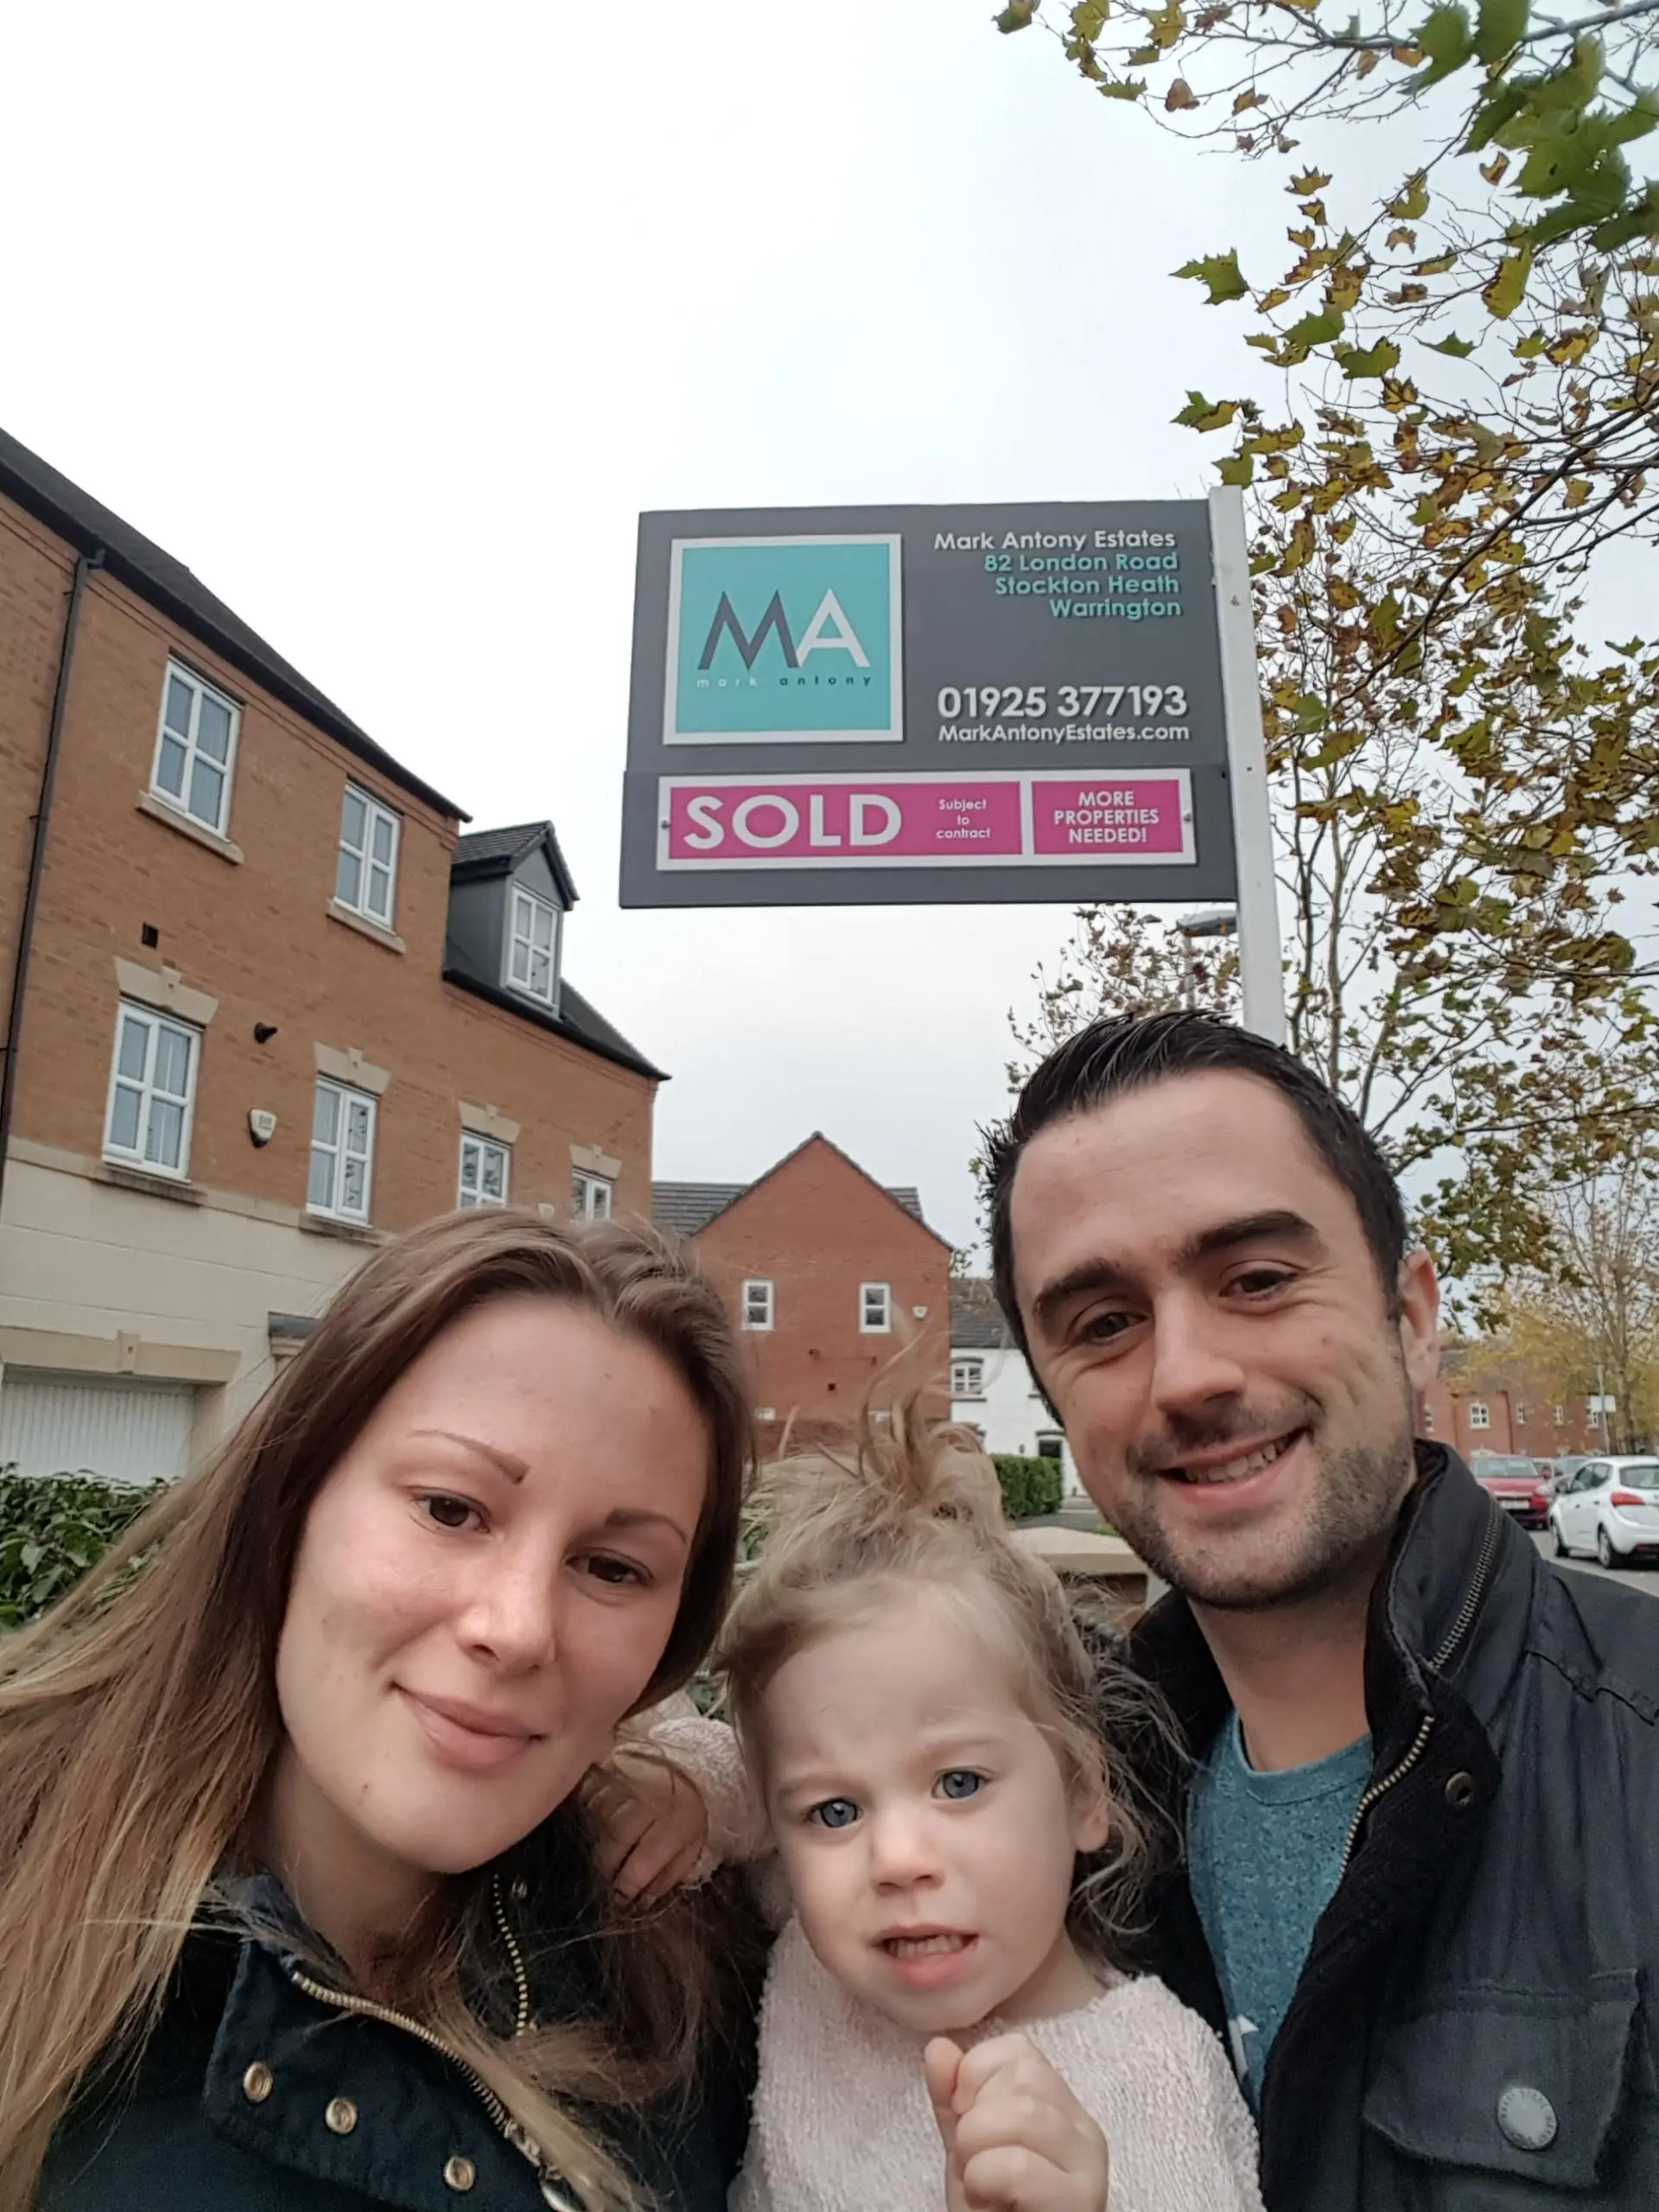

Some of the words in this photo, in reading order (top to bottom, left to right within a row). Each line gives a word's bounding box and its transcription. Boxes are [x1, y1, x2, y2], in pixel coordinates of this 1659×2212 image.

[934, 532, 994, 550] Mark
[1002, 531, 1086, 551] Antony
[1095, 530, 1175, 548] Estates
[984, 555, 1012, 572] 82
[1020, 553, 1108, 571] London
[1116, 552, 1178, 570] Road
[995, 575, 1100, 594] Stockton
[1108, 575, 1179, 594] Heath
[1050, 598, 1181, 620] Warrington
[697, 588, 871, 671] MA
[696, 676, 758, 688] mark
[779, 676, 871, 687] antony
[938, 686, 1046, 718] 01925
[1057, 685, 1188, 716] 377193
[938, 722, 1190, 744] MarkAntonyEstates.com
[938, 798, 987, 810] Subject
[1078, 791, 1135, 806] MORE
[683, 793, 902, 849] SOLD
[957, 816, 969, 826] to
[1053, 809, 1160, 825] PROPERTIES
[936, 828, 991, 839] contract
[1069, 828, 1147, 843] NEEDED!
